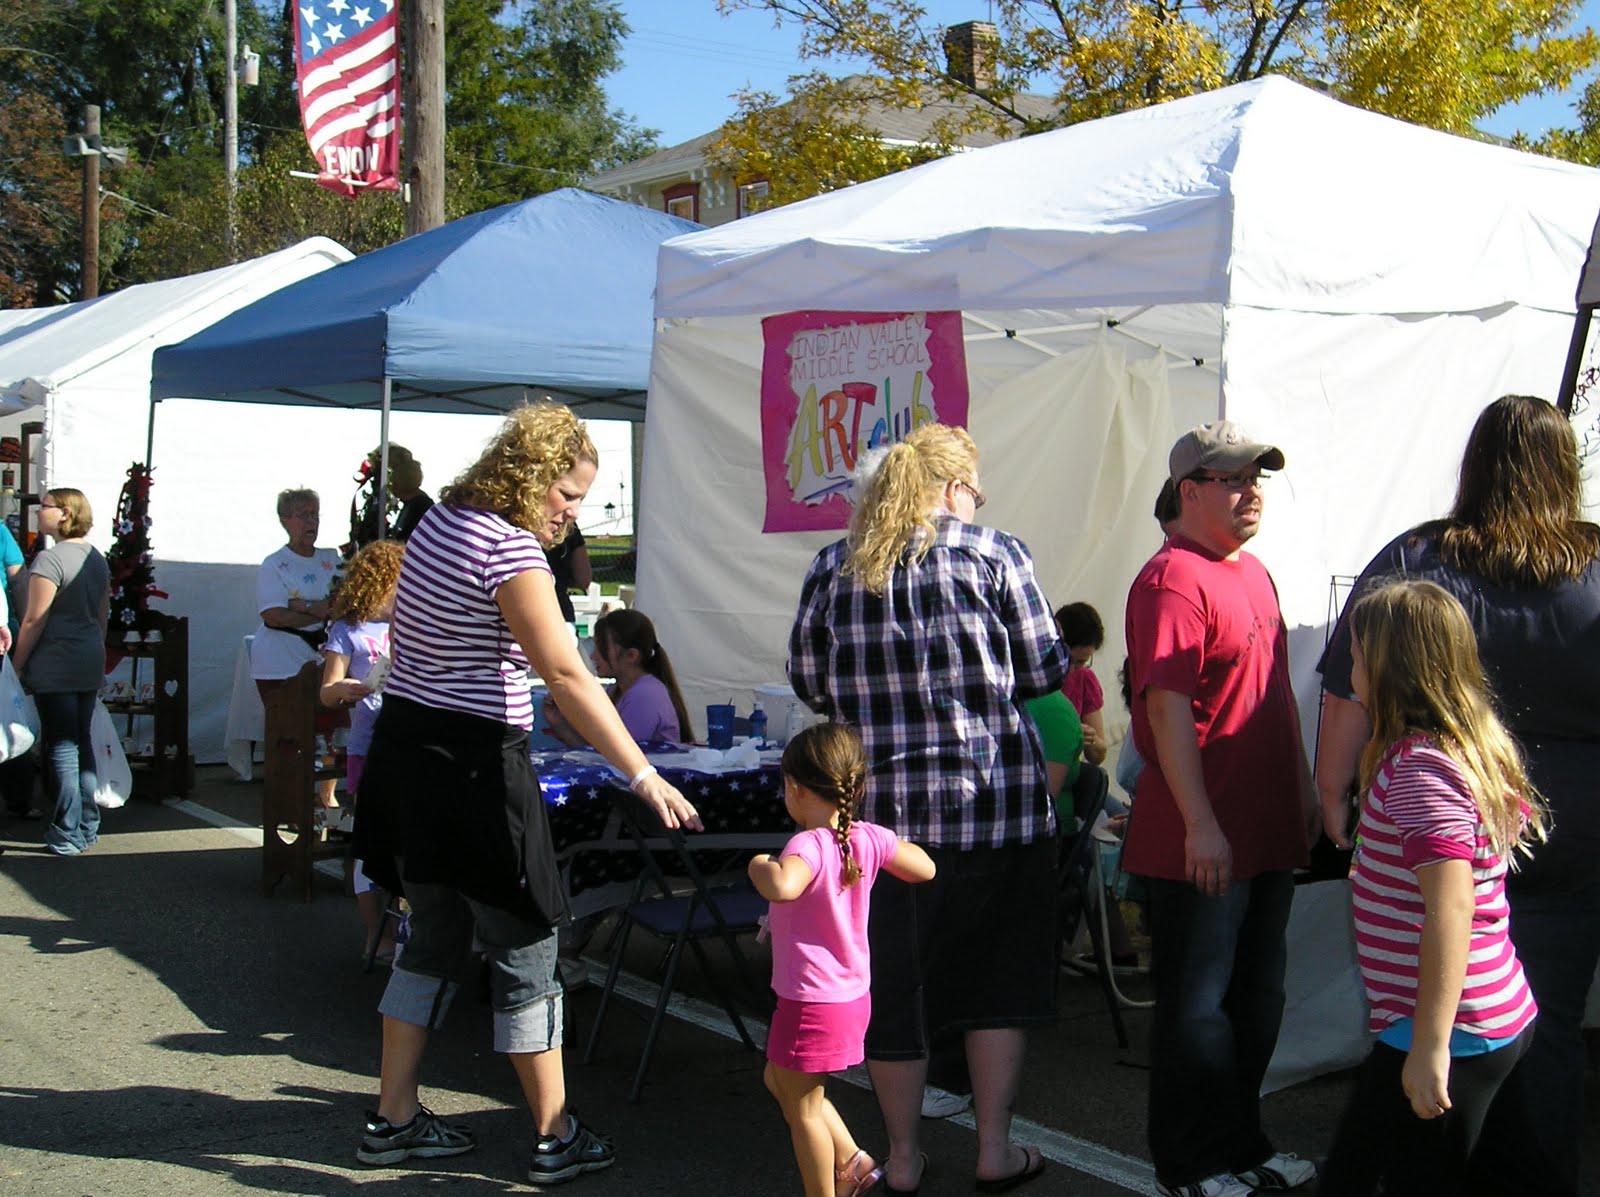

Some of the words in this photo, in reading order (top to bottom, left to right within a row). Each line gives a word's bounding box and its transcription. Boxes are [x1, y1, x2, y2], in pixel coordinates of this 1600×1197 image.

[323, 143, 380, 175] ENON
[794, 330, 859, 360] INDIAN
[869, 318, 925, 346] VALLEY
[793, 352, 855, 380] MIDDLE
[867, 343, 925, 371] SCHOOL
[791, 382, 877, 490] ART
